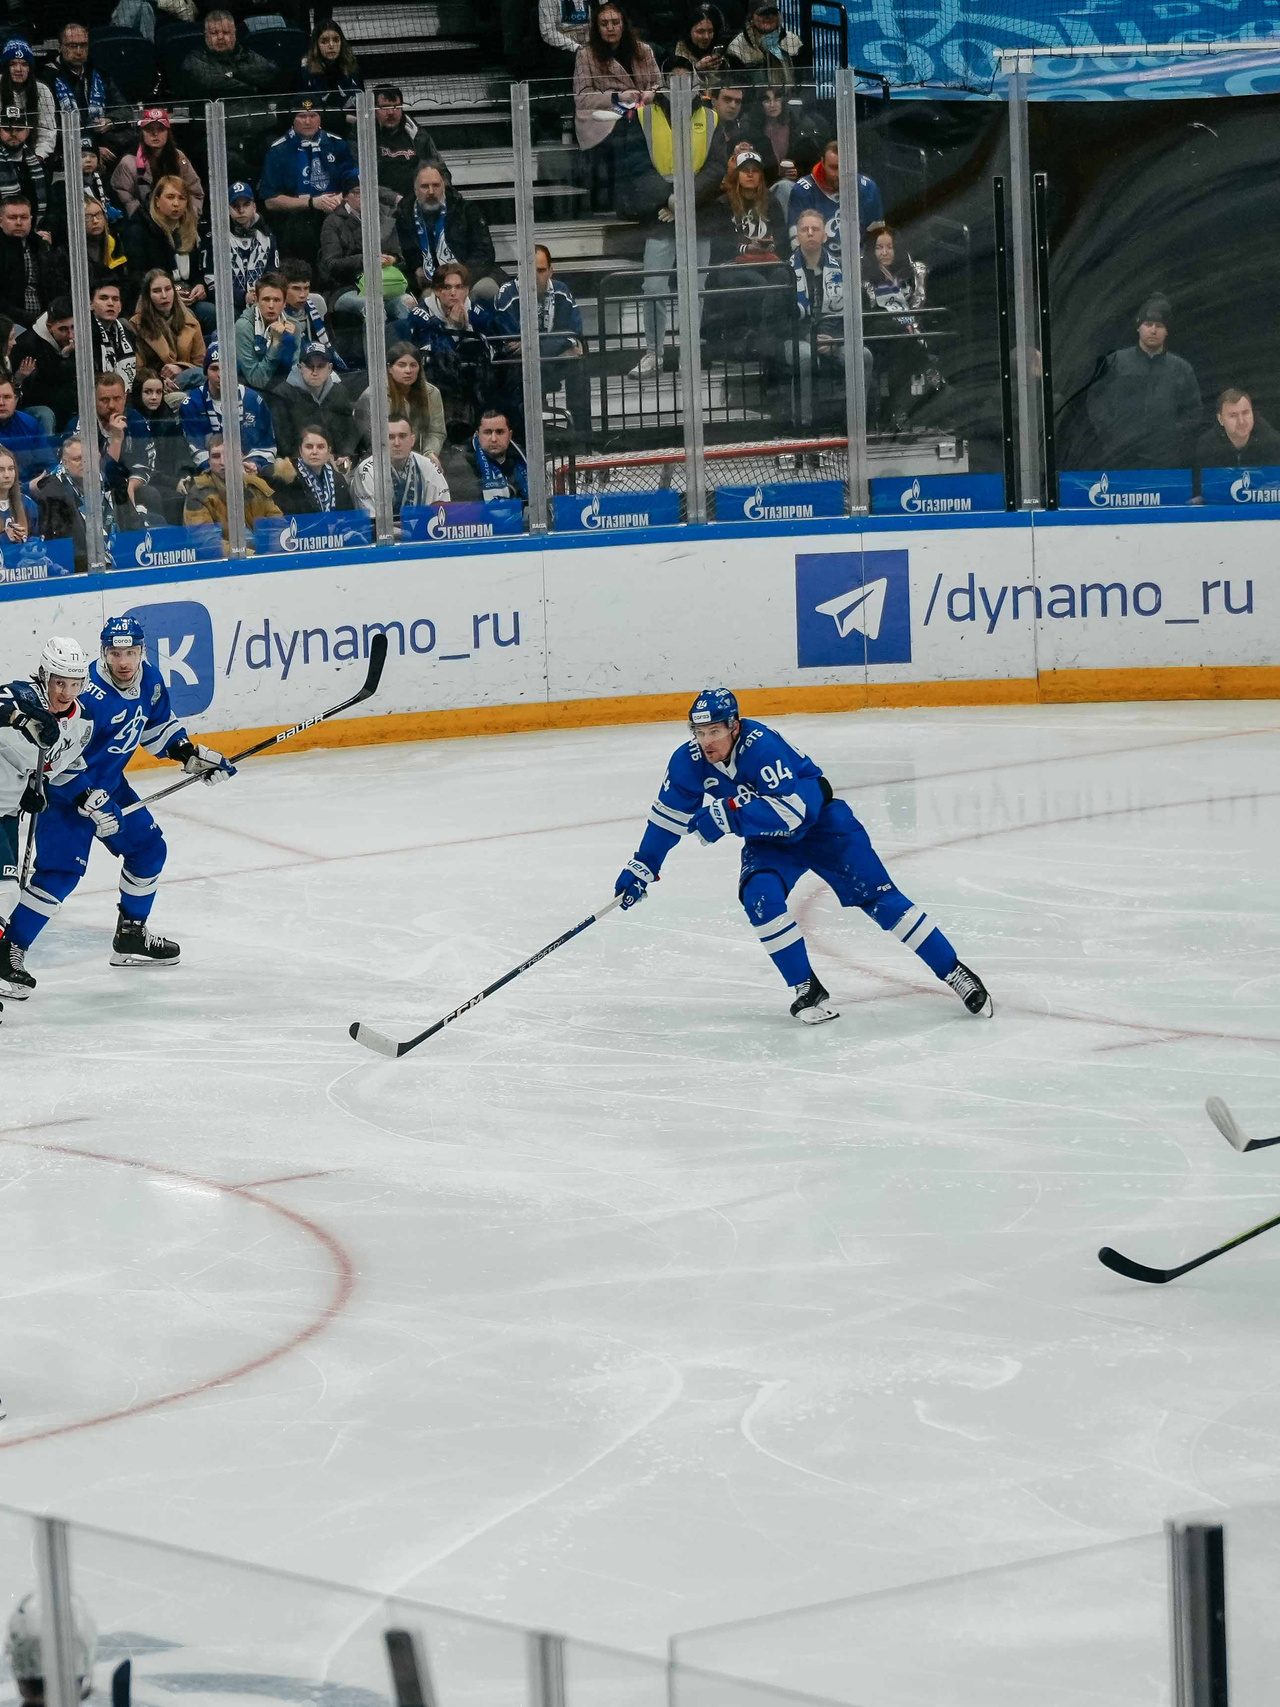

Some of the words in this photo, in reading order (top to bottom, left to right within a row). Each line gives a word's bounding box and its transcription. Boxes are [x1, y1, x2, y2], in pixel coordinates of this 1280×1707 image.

[1110, 493, 1160, 506] ГАЗПРОМ
[1252, 489, 1280, 502] ГАЗП
[764, 505, 813, 519] ГАЗПРОМ
[922, 498, 971, 511] ГАЗПРОМ
[601, 513, 649, 528] ГАЗПРОМ
[447, 524, 493, 539] ГАЗПРОМ
[300, 534, 344, 550] ГАЗПРОМ
[154, 548, 196, 565] ГАЗПРОМ
[5, 565, 48, 582] ГАЗПРОМ
[923, 572, 1253, 634] /dynamo_ru
[225, 611, 520, 681] /dynamo_ru
[157, 634, 200, 688] K
[745, 728, 764, 748] ВТБ
[760, 759, 793, 790] 94
